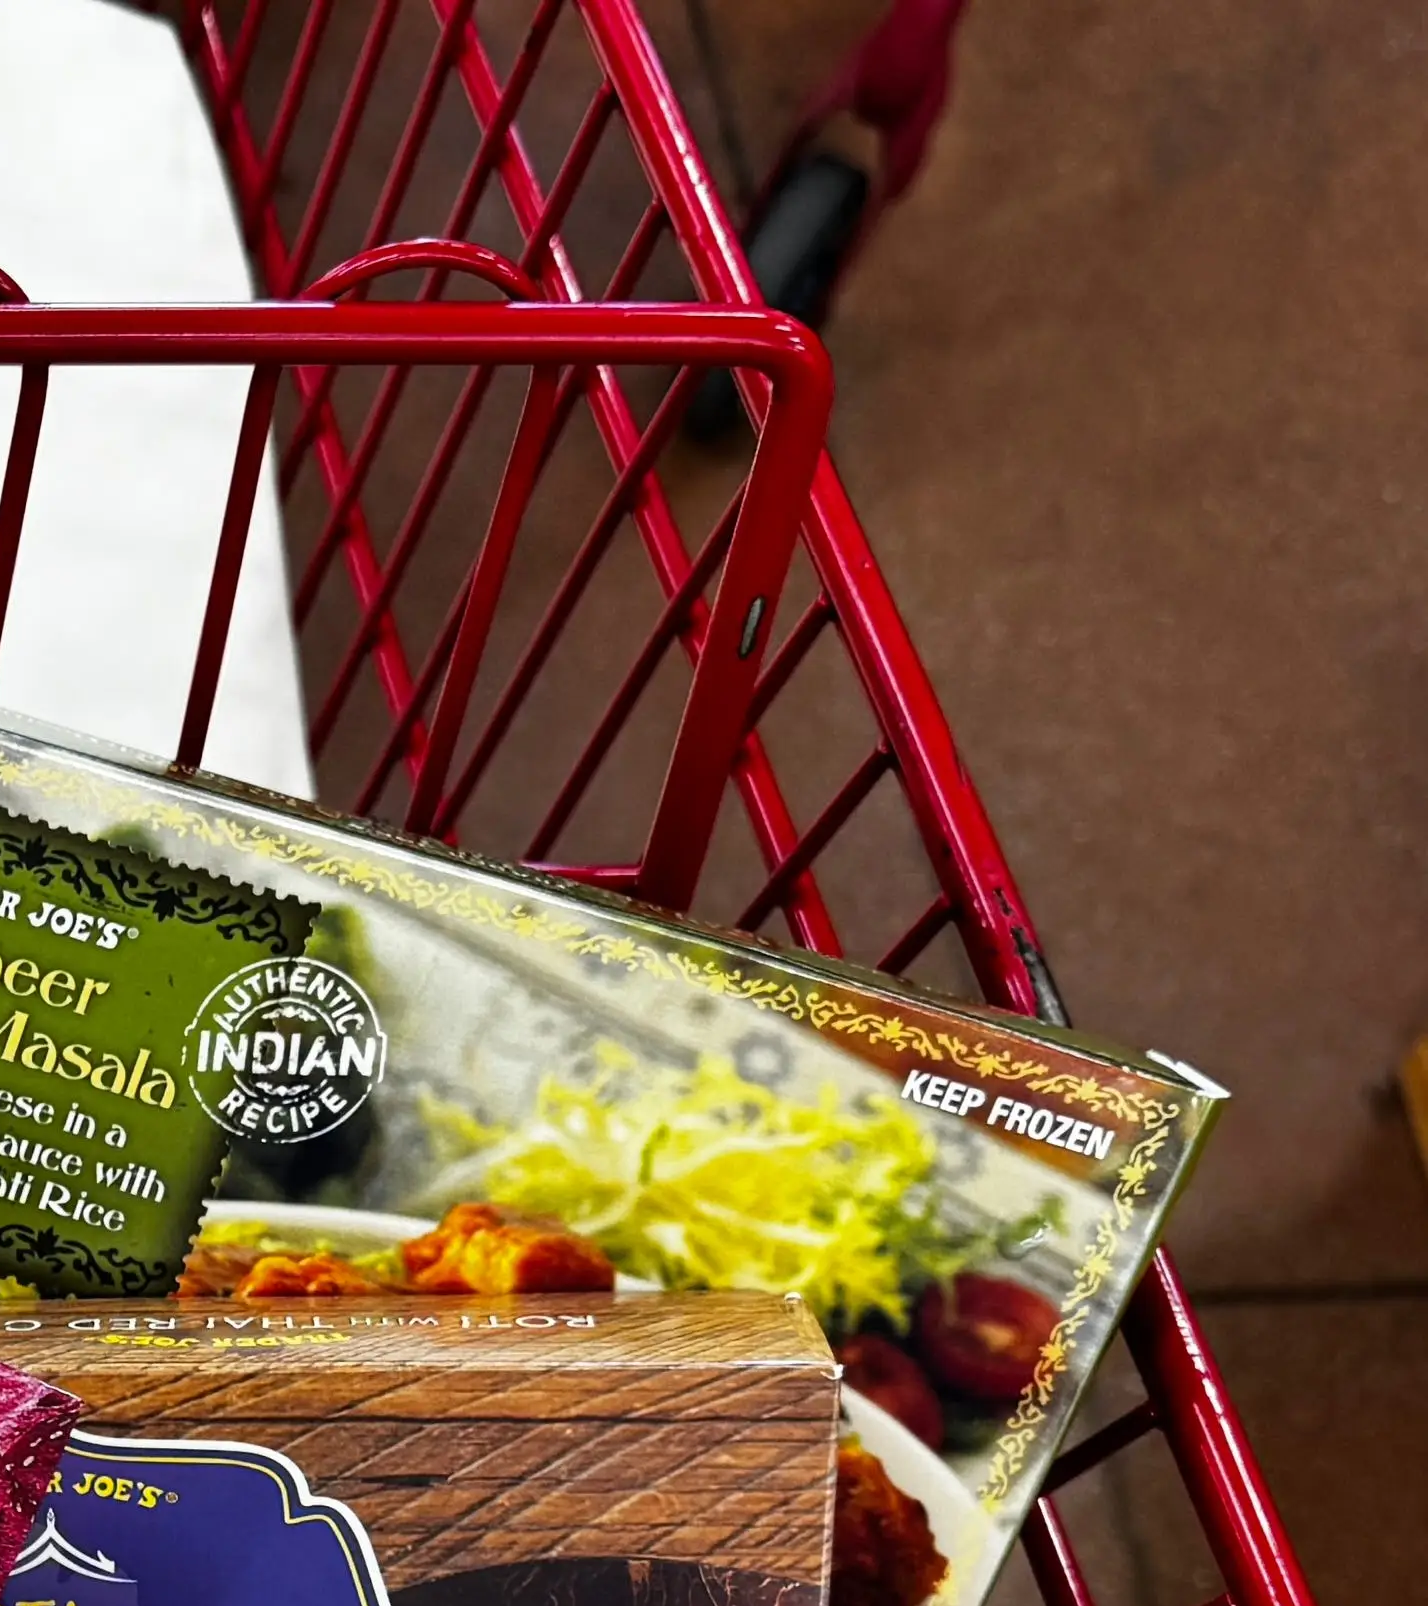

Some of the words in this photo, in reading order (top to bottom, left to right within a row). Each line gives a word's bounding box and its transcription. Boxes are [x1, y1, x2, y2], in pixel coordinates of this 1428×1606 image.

[212, 966, 366, 1034] AUTHENTIC
[197, 1029, 377, 1077] INDIAN
[62, 1102, 96, 1139] in
[104, 1123, 128, 1148] a
[217, 1086, 348, 1133] RECIPE
[901, 1069, 986, 1116] KEEP
[987, 1096, 1115, 1160] FROZEN
[95, 1160, 166, 1204] with
[38, 1181, 126, 1233] Rice
[68, 1317, 176, 1331] RED
[205, 1316, 334, 1330] THAI
[350, 1315, 440, 1327] WITH
[461, 1315, 595, 1329] ROTI
